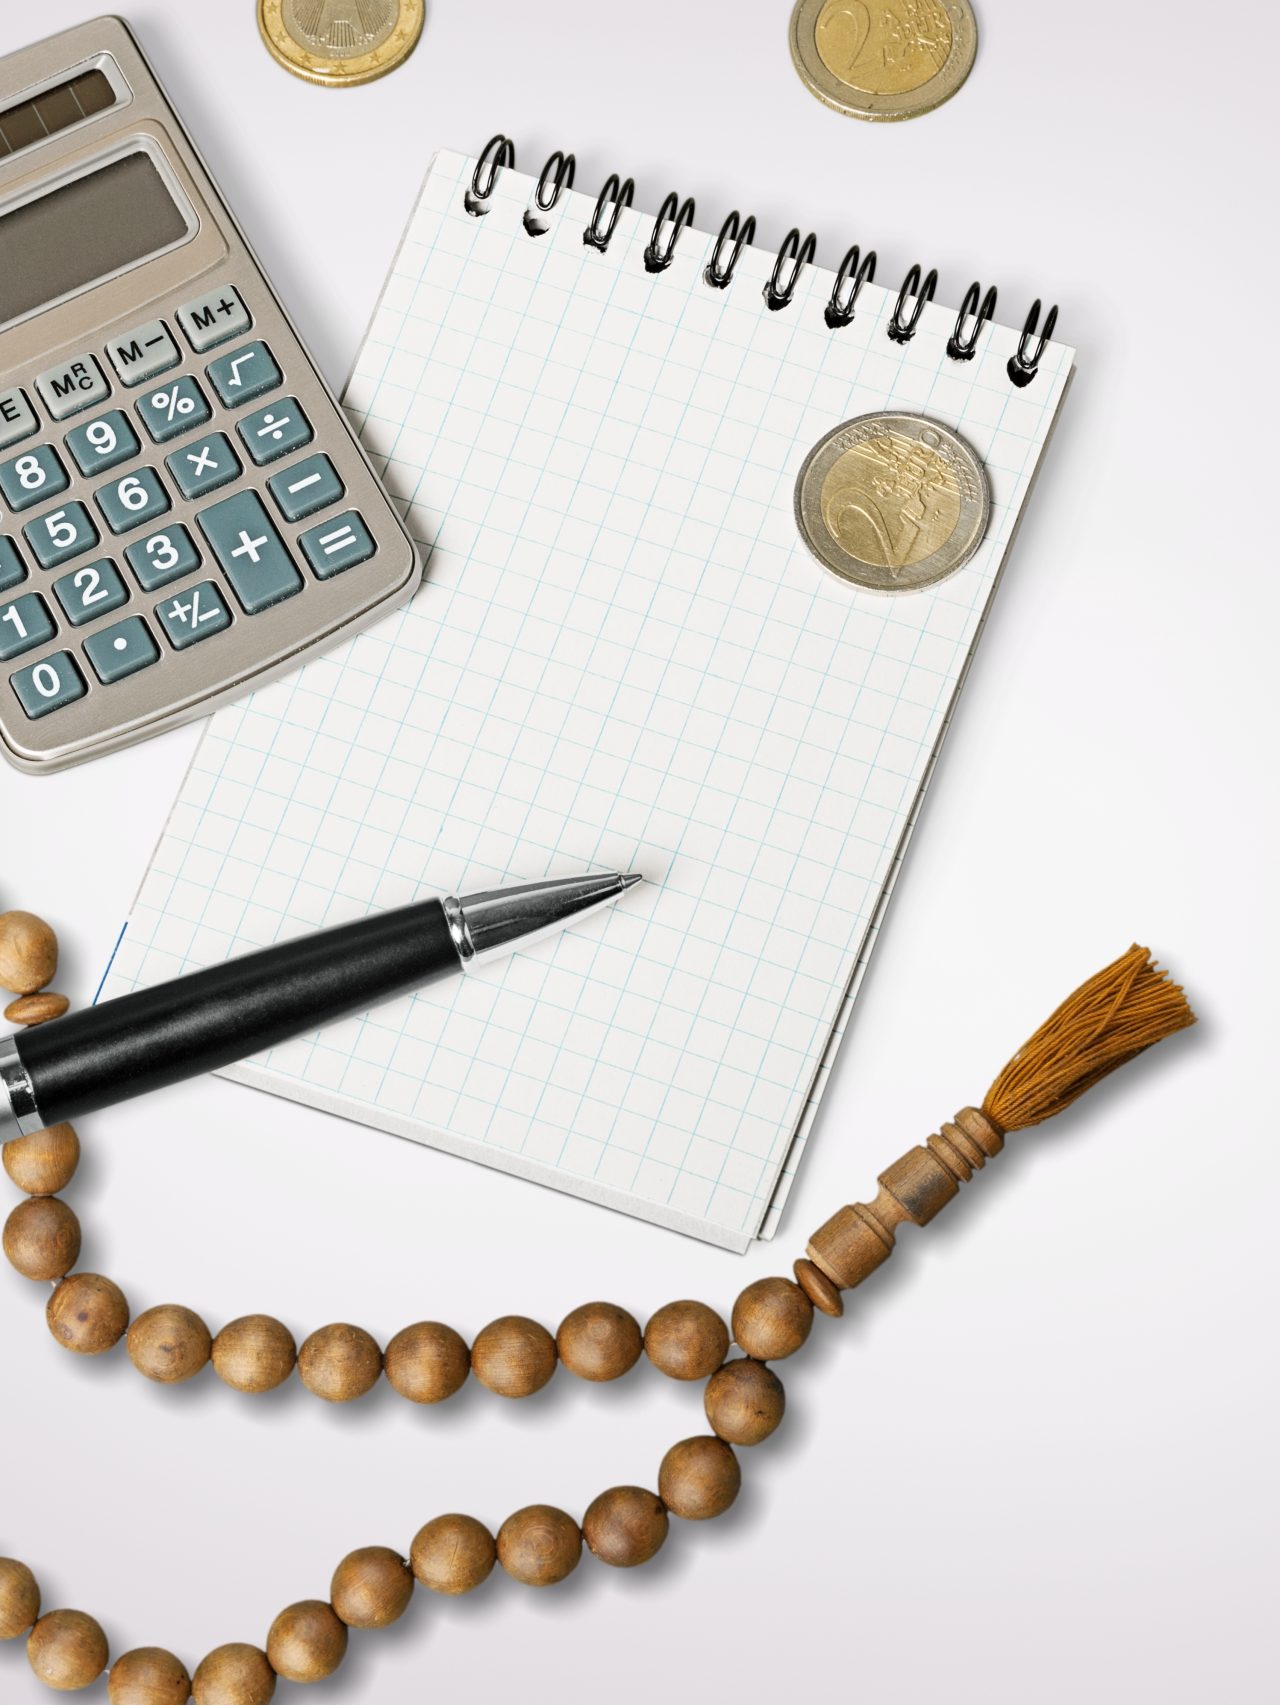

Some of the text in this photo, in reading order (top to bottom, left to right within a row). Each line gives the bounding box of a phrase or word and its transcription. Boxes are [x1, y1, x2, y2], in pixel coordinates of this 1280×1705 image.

[821, 0, 886, 78] 2
[190, 298, 235, 331] M+
[14, 455, 46, 489] 8
[86, 421, 117, 455] 9
[151, 387, 195, 422] %
[44, 510, 77, 548] 5
[117, 476, 149, 511] 6
[826, 486, 921, 579] 2
[2, 605, 28, 638] 1
[73, 567, 109, 606] 2
[146, 534, 179, 570] 3
[231, 530, 268, 563] +
[32, 663, 61, 698] 0
[318, 525, 357, 555] =
